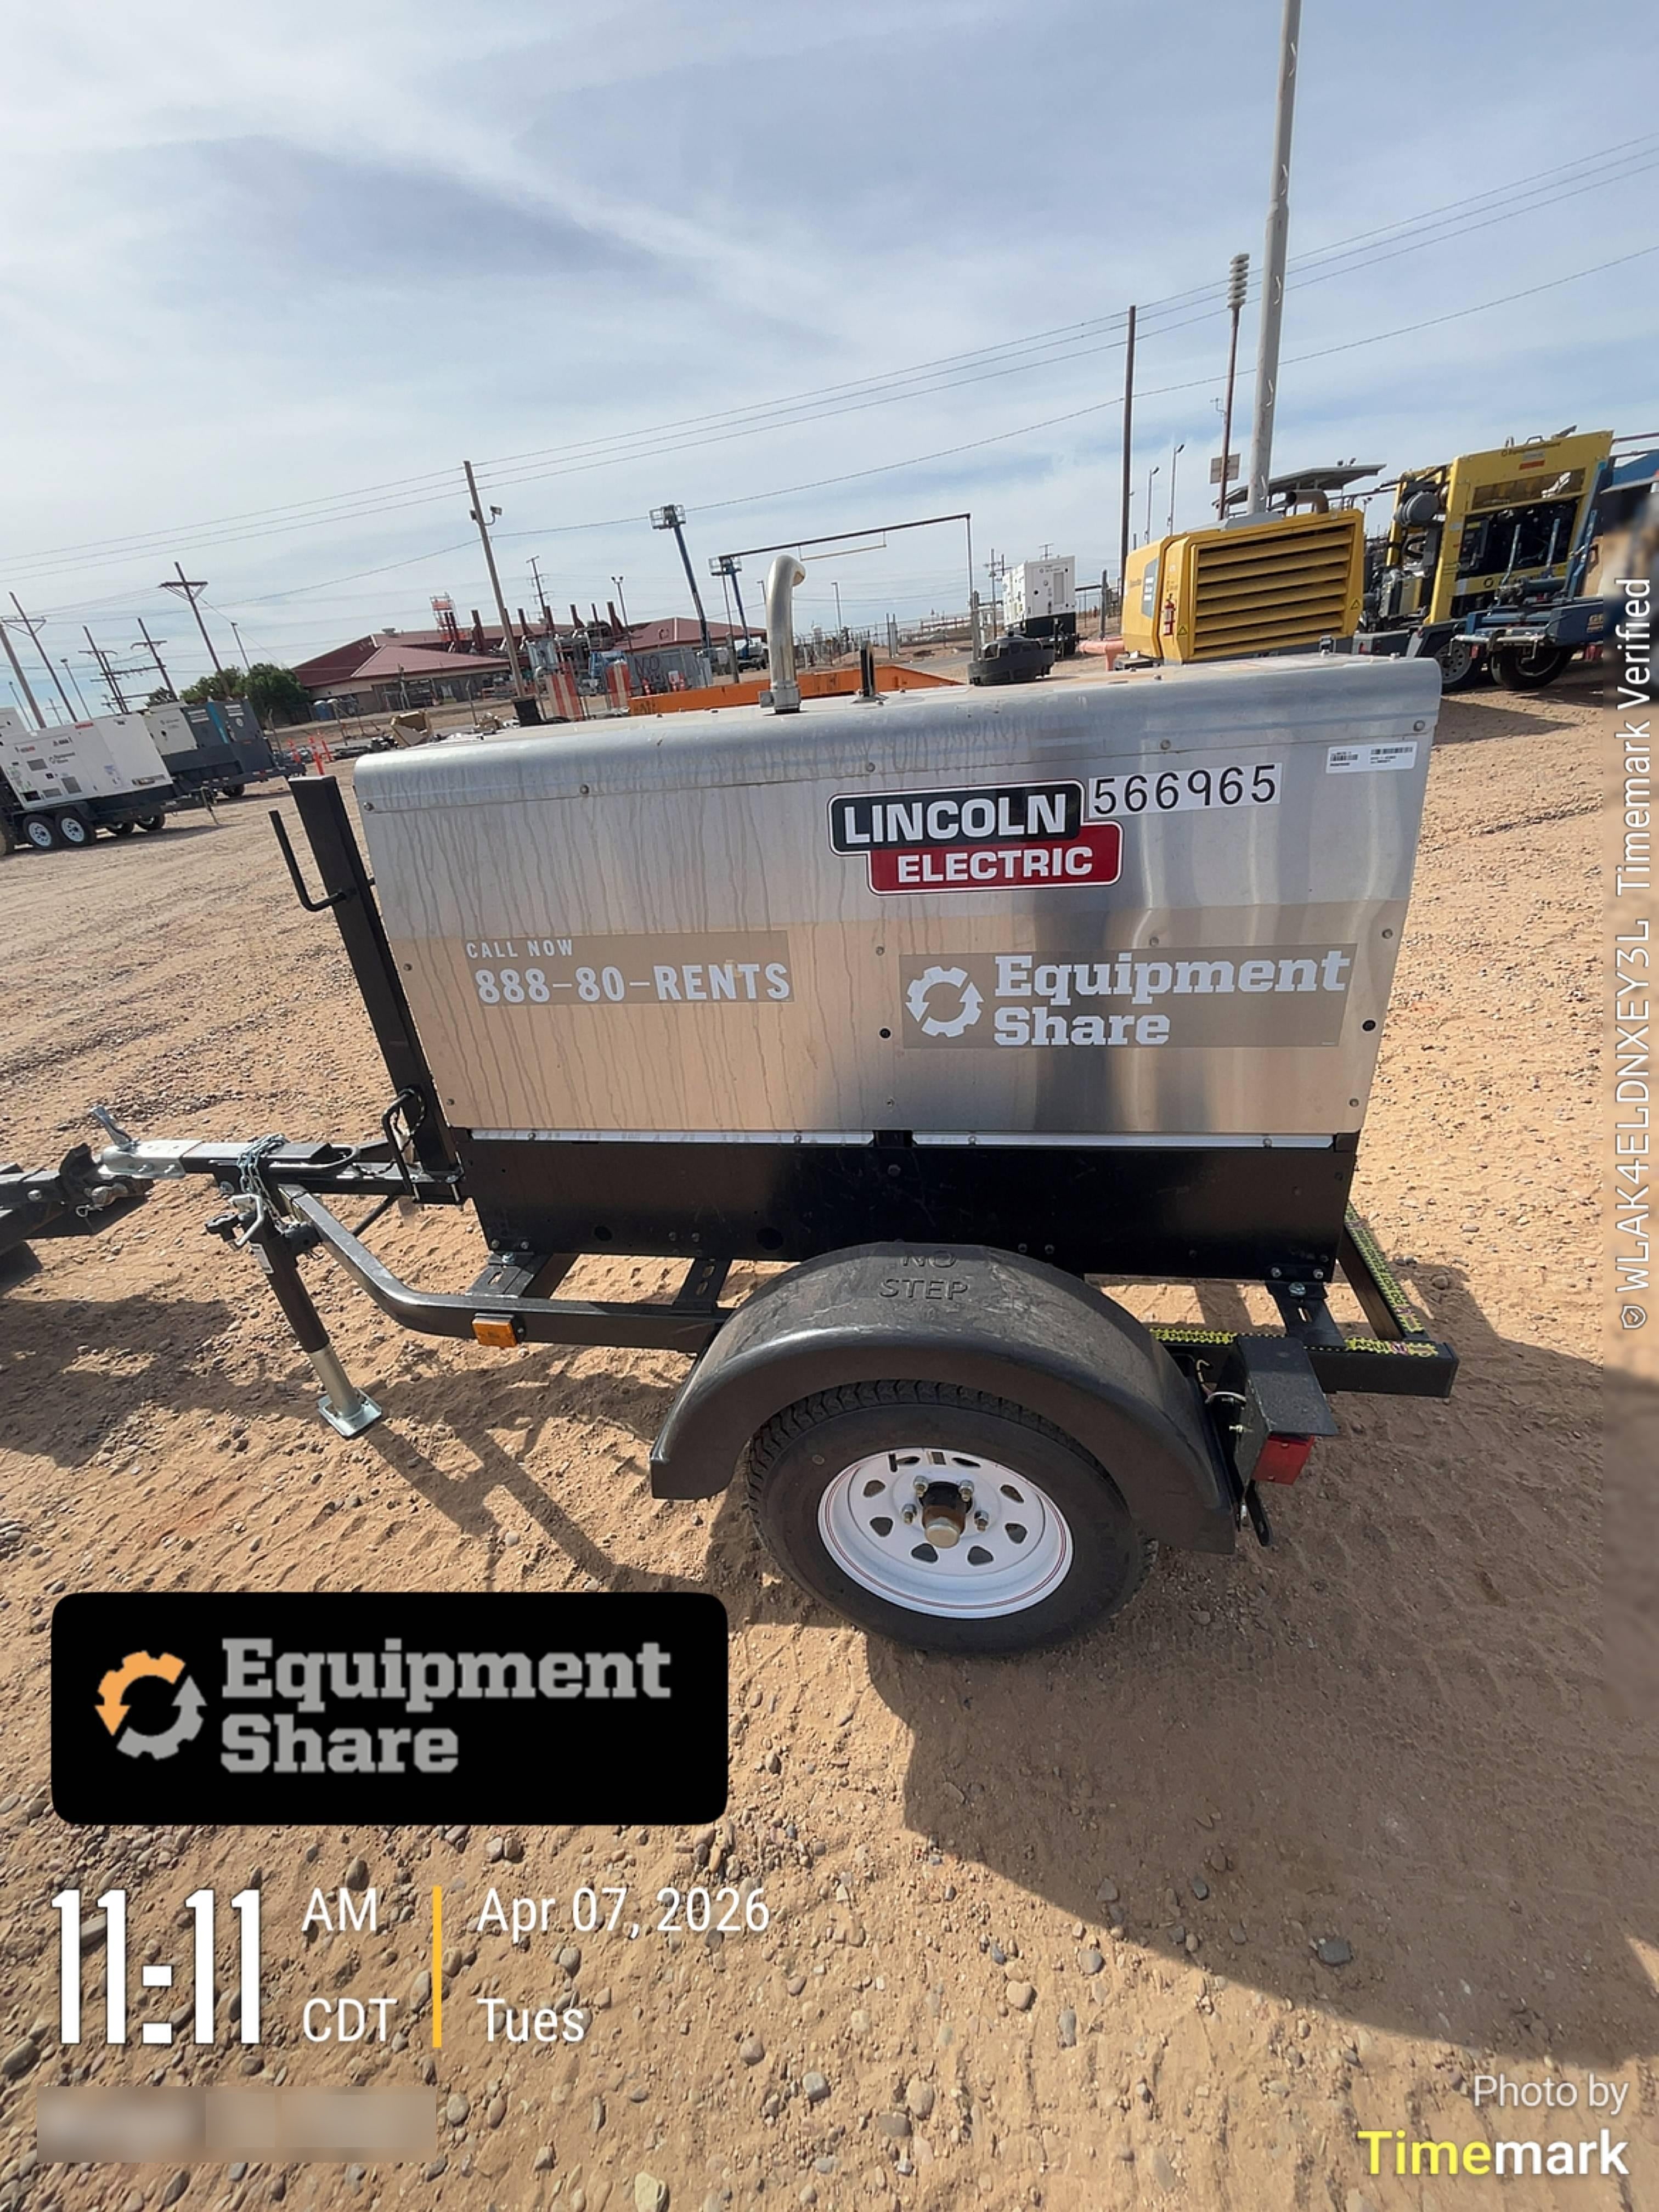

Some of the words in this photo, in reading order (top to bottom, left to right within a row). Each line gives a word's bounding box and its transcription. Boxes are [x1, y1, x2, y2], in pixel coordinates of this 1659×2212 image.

[1094, 764, 1276, 815] 566965
[843, 793, 1067, 845] LINCOLN
[897, 847, 1093, 883] ELECTRIC
[466, 941, 518, 959] CALL
[528, 939, 573, 957] NOW
[475, 963, 790, 1003] 888-80-RENTS
[994, 950, 1351, 1006] Equipment
[993, 1006, 1170, 1046] Share
[900, 1250, 957, 1268] NO
[878, 1278, 969, 1300] STEP
